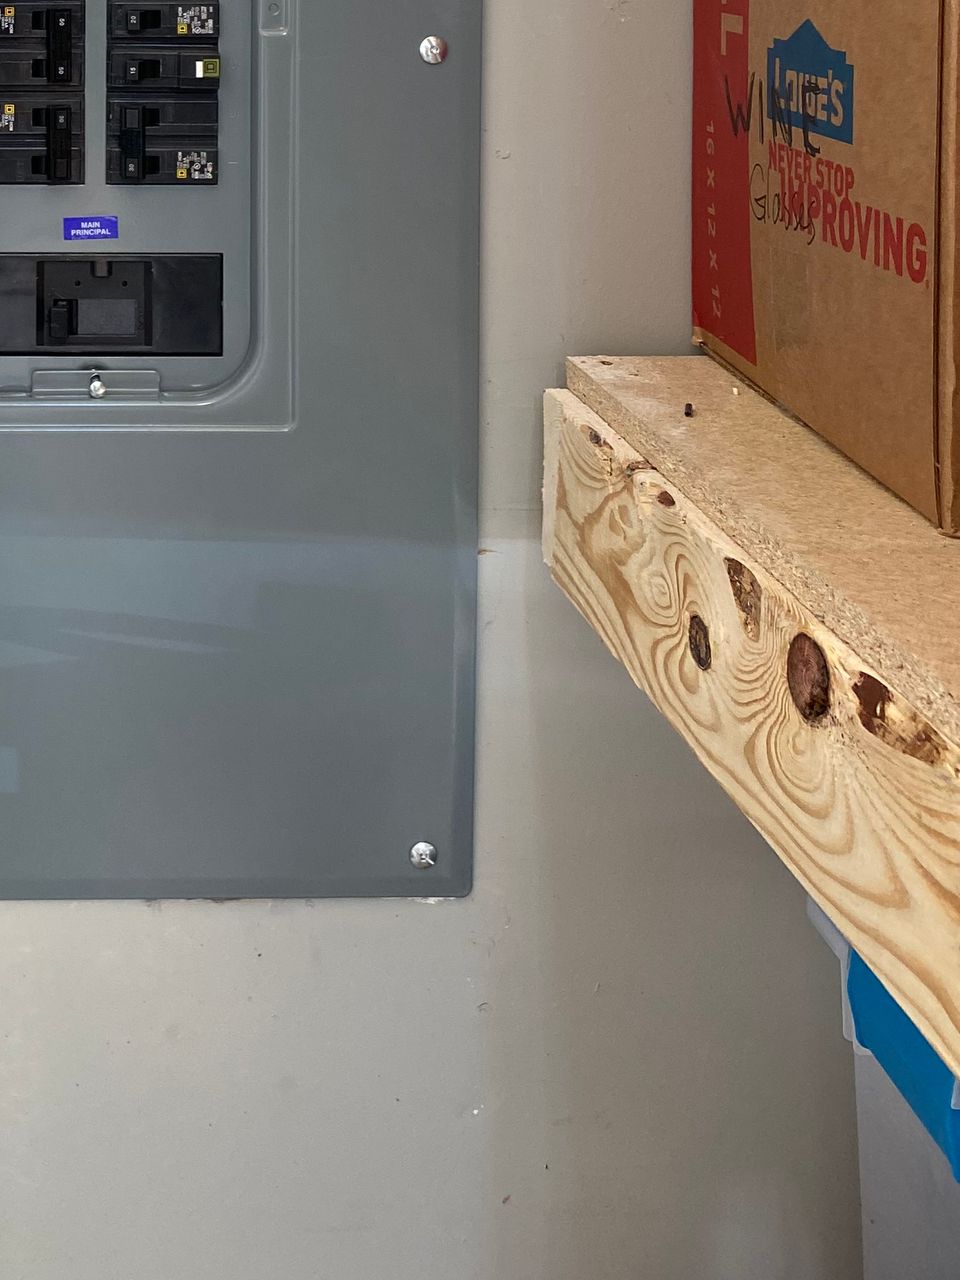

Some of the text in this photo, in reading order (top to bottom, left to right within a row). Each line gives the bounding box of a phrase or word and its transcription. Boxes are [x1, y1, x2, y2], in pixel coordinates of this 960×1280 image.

[130, 15, 137, 24] 20
[58, 66, 64, 75] 50
[774, 57, 845, 129] LOWE'S
[725, 71, 821, 157] WINE
[129, 163, 135, 172] 30
[768, 139, 856, 199] NEVER STOP
[71, 228, 111, 236] PRINCIPAL
[80, 221, 101, 229] MAIN
[705, 120, 721, 318] 16 X 12 X 12
[748, 163, 817, 245] Glasses
[780, 171, 928, 285] IMPROVING
